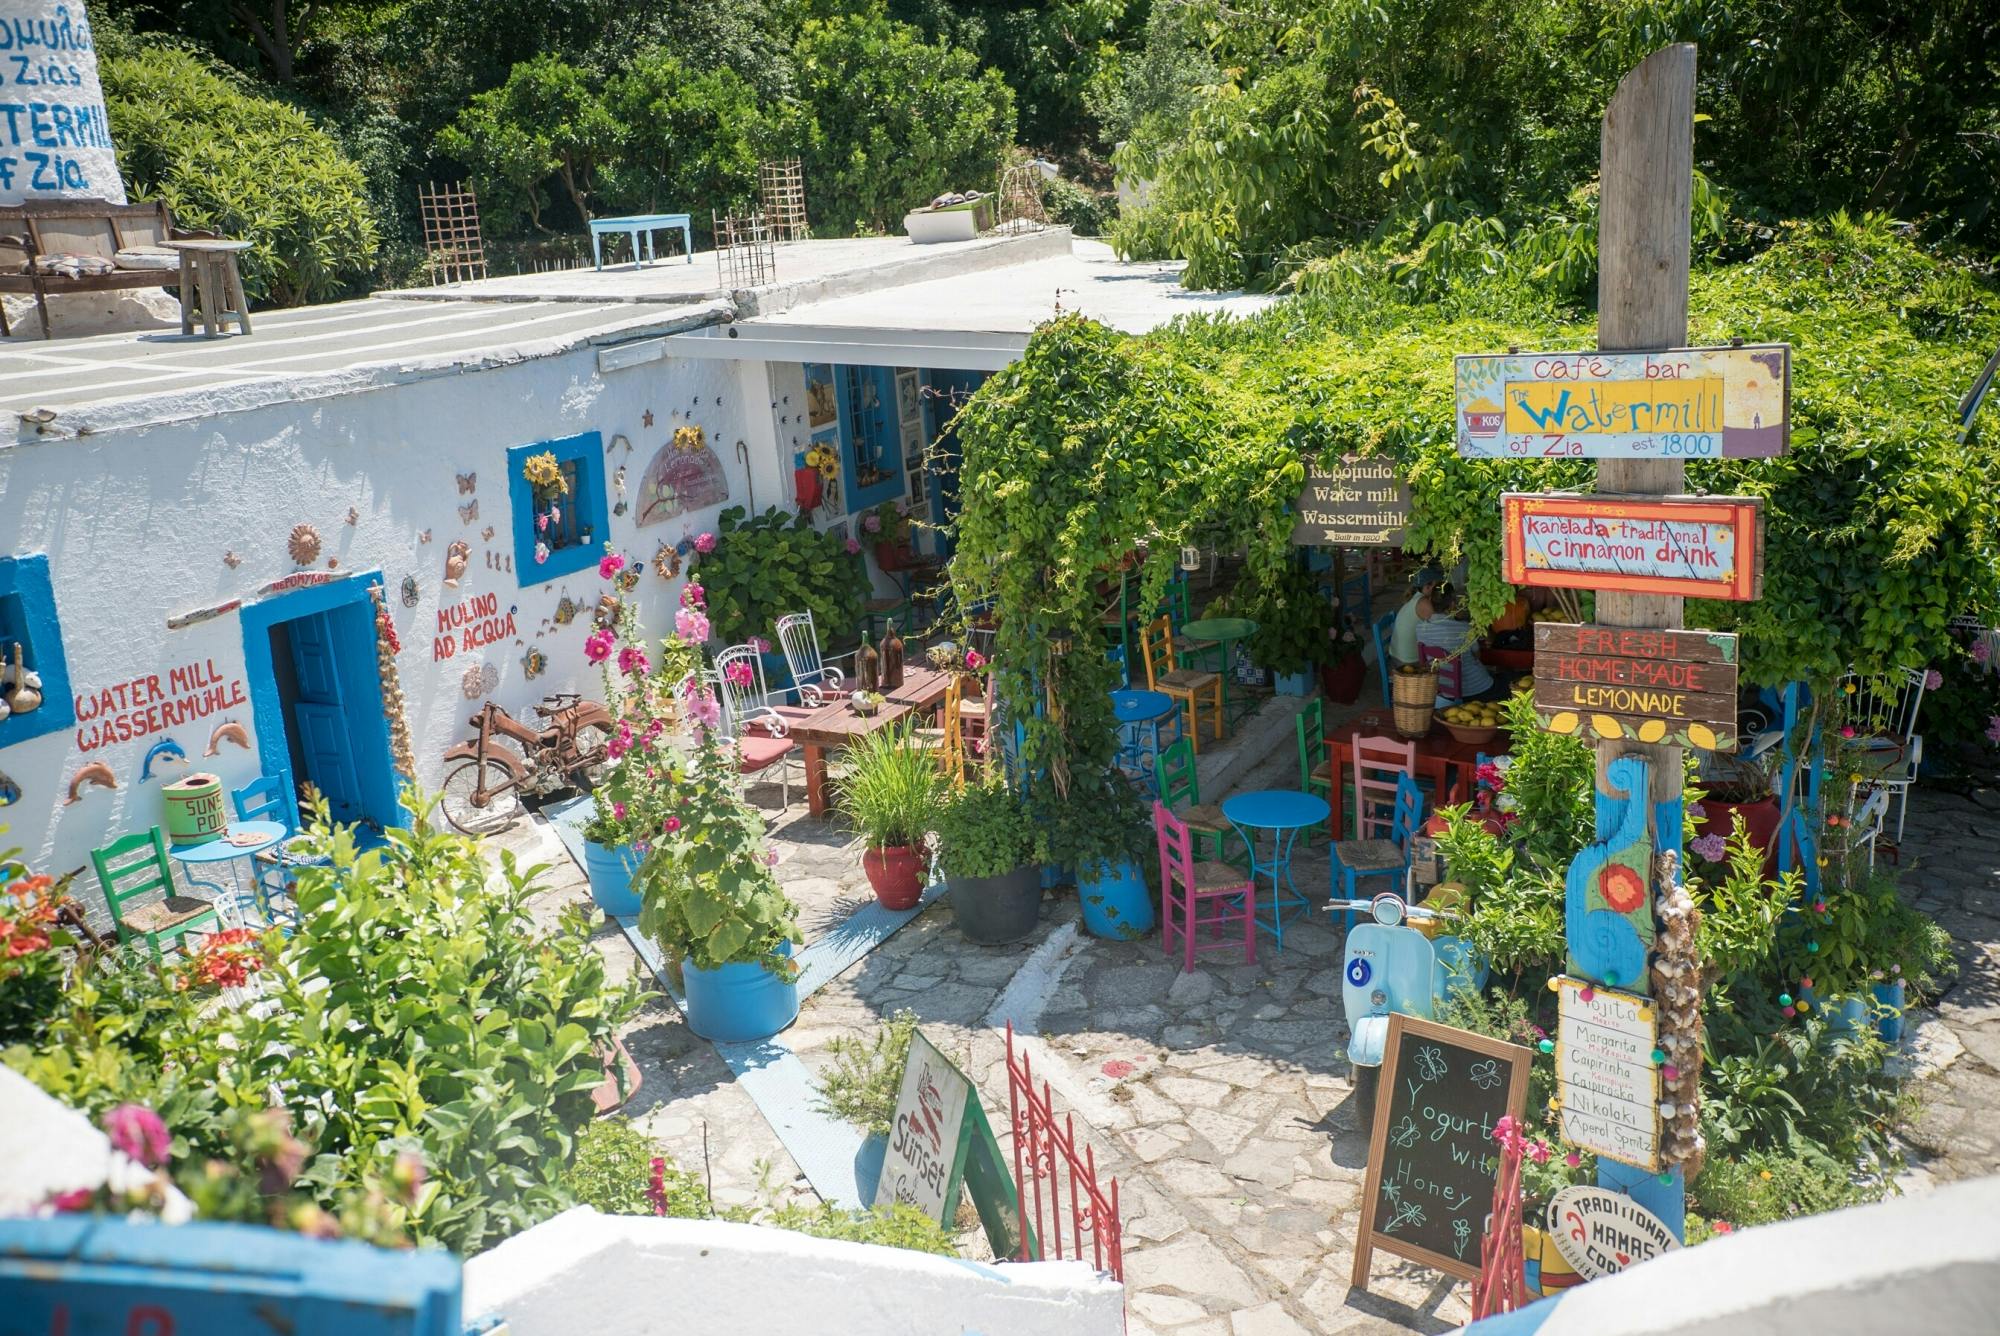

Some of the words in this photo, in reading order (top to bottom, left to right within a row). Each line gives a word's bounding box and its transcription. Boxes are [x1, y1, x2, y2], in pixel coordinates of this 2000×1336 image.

[0, 103, 113, 147] TERMILL
[24, 152, 89, 190] Zia
[1534, 357, 1612, 379] café
[1645, 356, 1690, 379] bar
[1467, 416, 1472, 426] I
[1482, 415, 1501, 426] KOS
[1517, 388, 1717, 432] Watermill
[1510, 435, 1533, 454] of
[1543, 434, 1584, 456] Zia
[1660, 434, 1713, 456] 1800
[1313, 486, 1362, 502] Water
[1367, 488, 1398, 502] mill
[1655, 543, 1719, 568] drink
[437, 592, 497, 633] MULINO
[434, 635, 456, 662] AD
[462, 612, 517, 652] ACQUA
[1576, 630, 1679, 658] FRESH
[75, 675, 165, 722] WATER
[169, 659, 223, 696] MILL
[1573, 686, 1686, 716] LEMONADE
[77, 680, 247, 752] WASSERMÜHLE
[1576, 1025, 1636, 1053] Margarita
[1569, 1114, 1609, 1138] Aperol
[1573, 1092, 1636, 1125] Nikolaki
[893, 1114, 945, 1199] Sunset
[1397, 1159, 1472, 1211] Honey
[1573, 1197, 1671, 1253] TRADITIONAL
